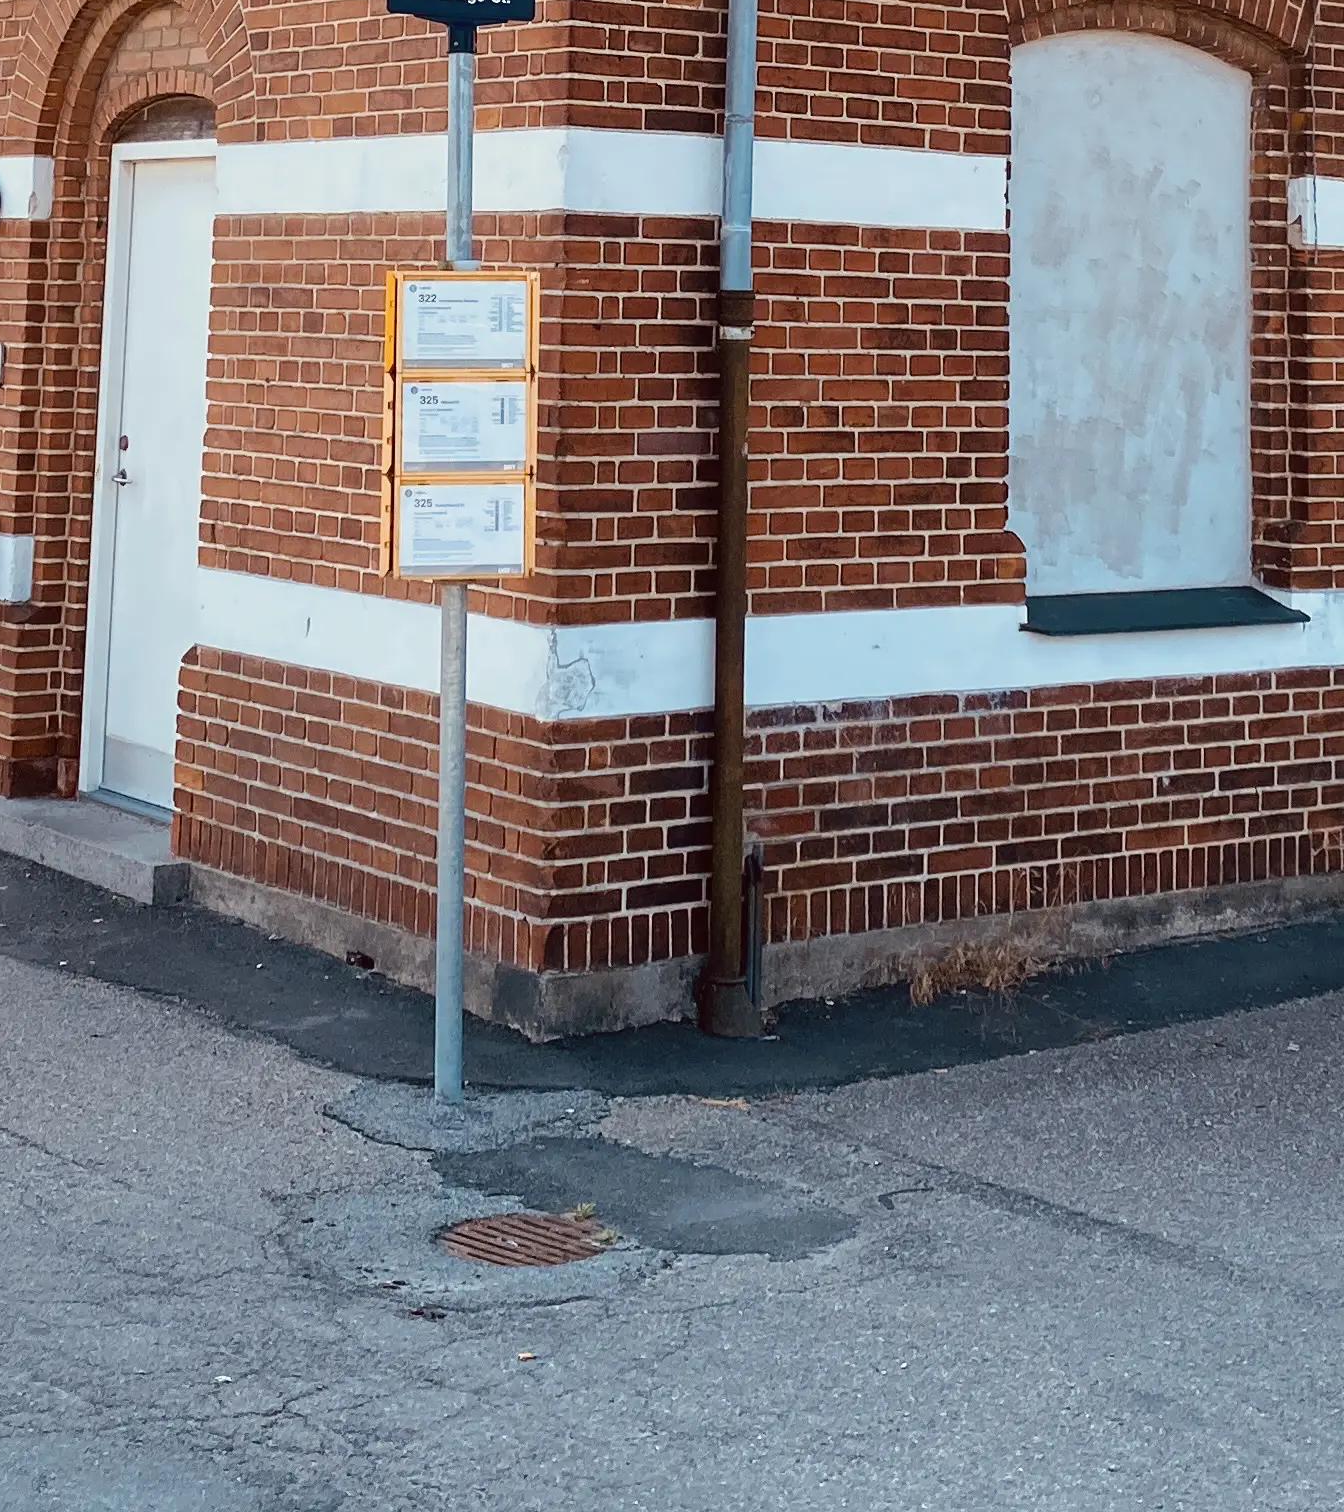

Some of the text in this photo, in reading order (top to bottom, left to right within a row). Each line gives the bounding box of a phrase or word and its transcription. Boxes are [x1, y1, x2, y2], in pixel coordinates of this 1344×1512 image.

[418, 294, 437, 303] 322
[419, 396, 439, 405] 325
[414, 498, 433, 508] 325
